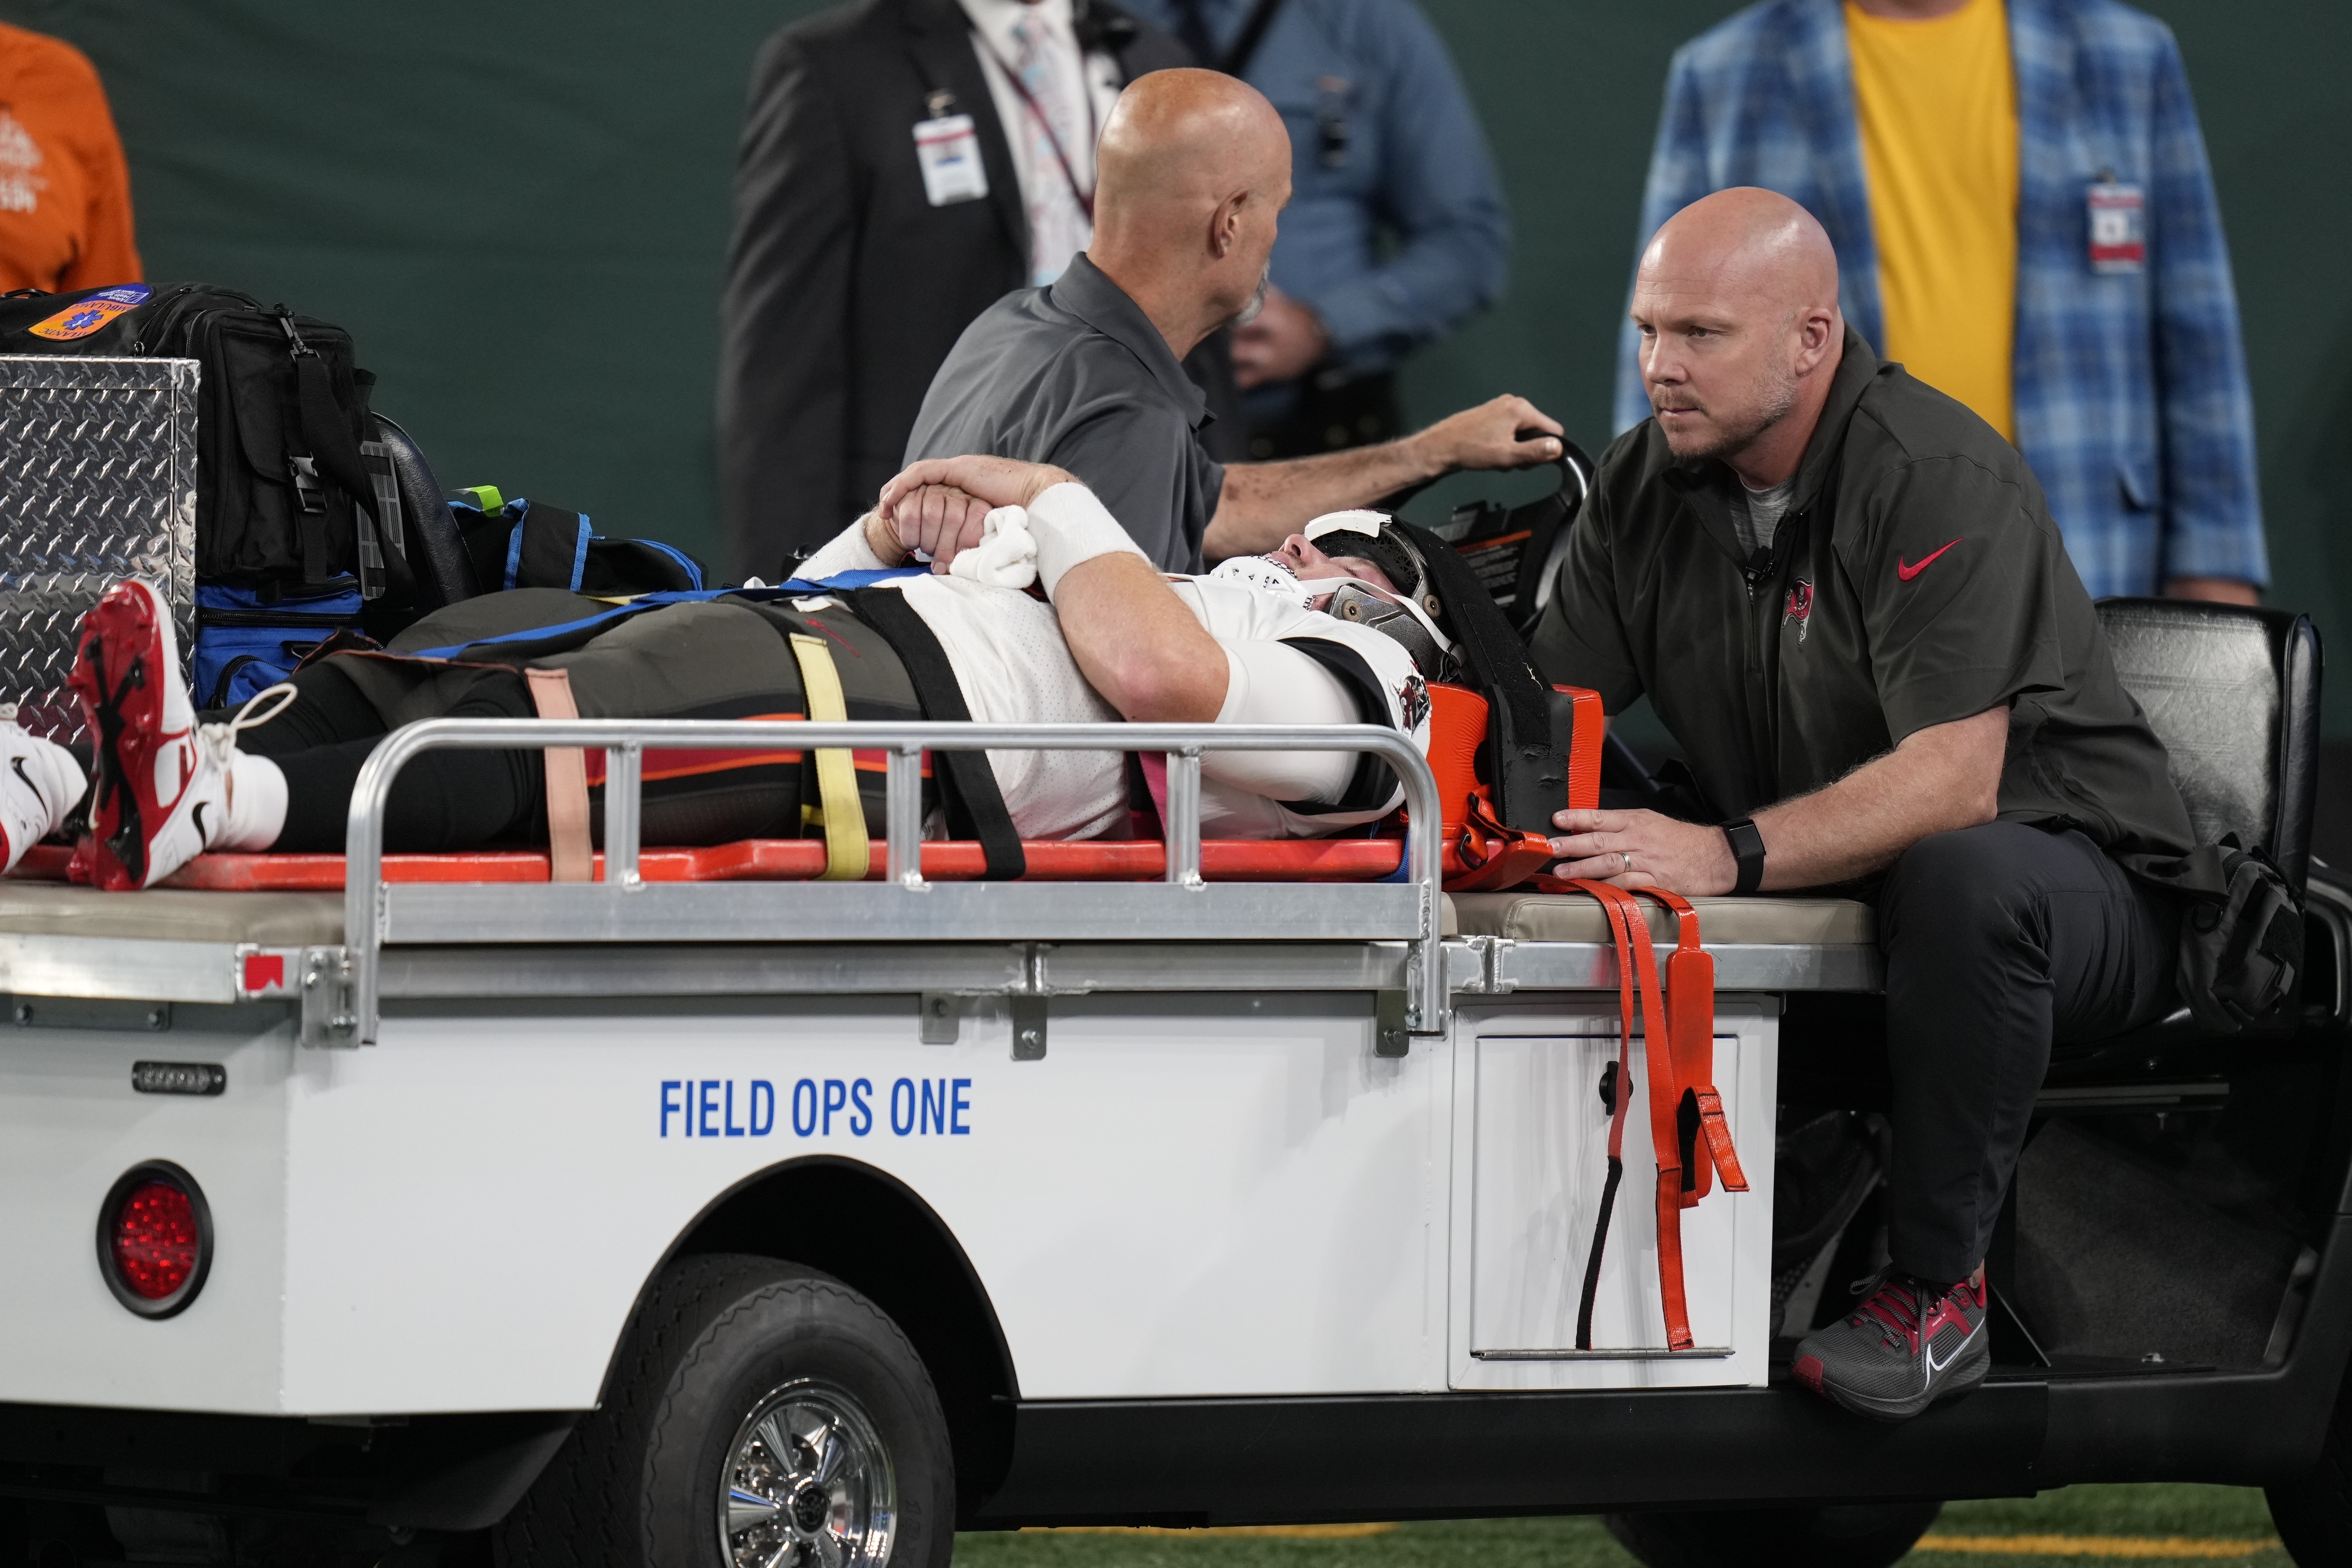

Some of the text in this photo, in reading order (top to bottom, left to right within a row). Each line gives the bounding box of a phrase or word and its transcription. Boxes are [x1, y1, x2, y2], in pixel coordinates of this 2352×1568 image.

[38, 328, 92, 338] ATLANTIC
[660, 1078, 971, 1138] FIELD OPS ONE
[1932, 1316, 1942, 1327] PEGASUS
